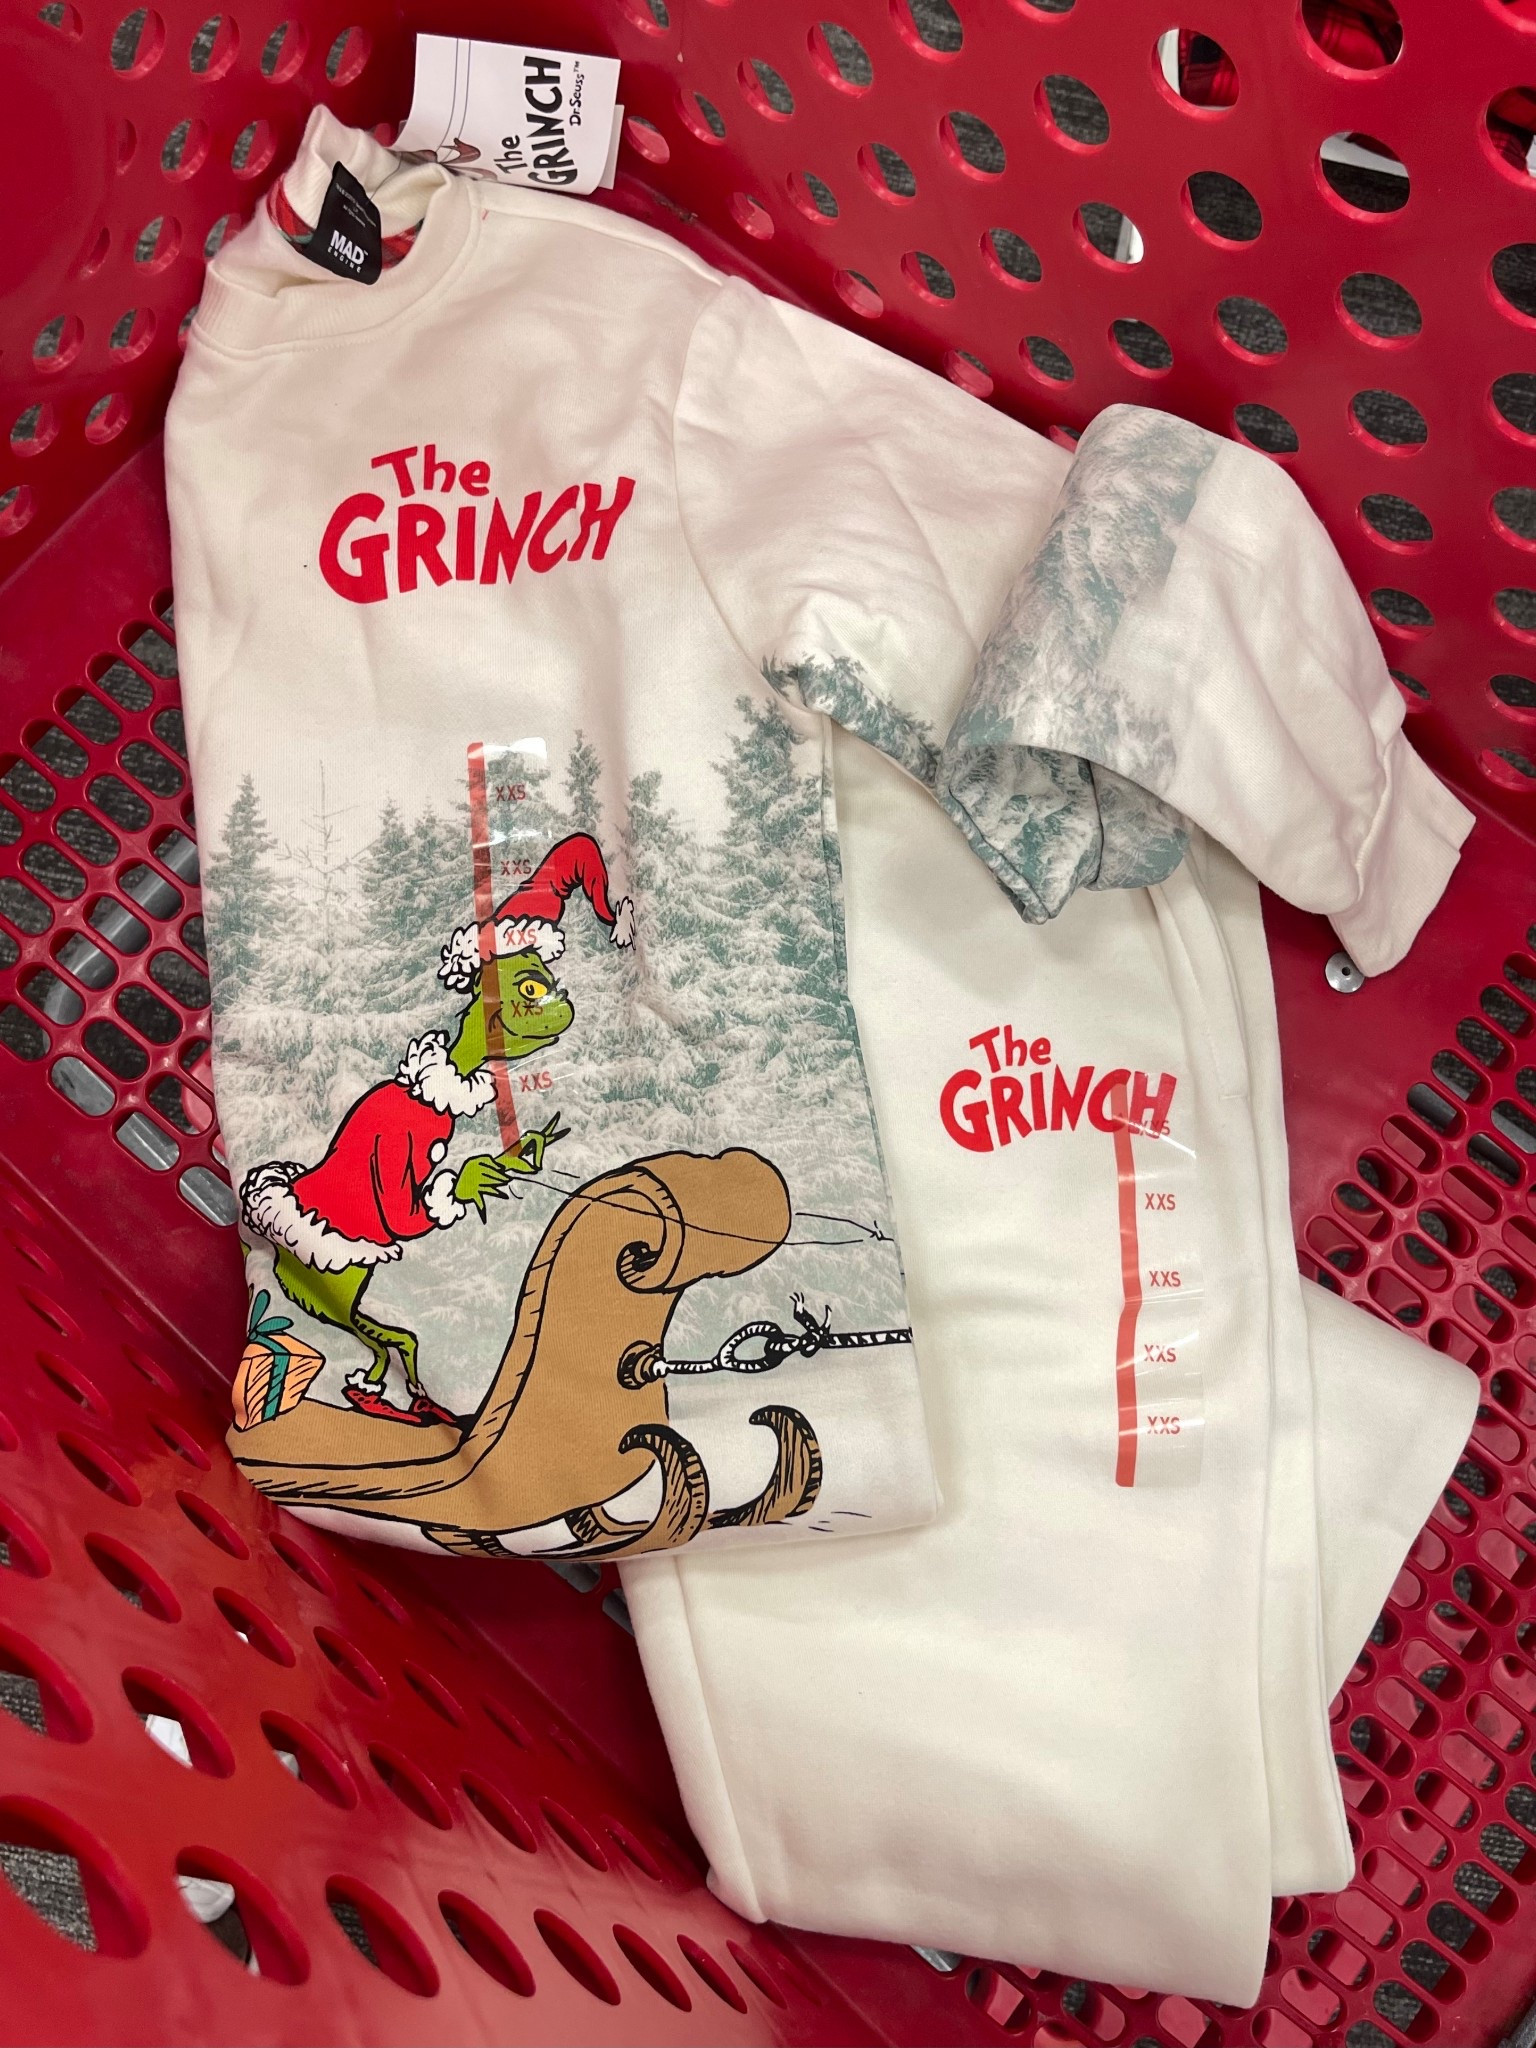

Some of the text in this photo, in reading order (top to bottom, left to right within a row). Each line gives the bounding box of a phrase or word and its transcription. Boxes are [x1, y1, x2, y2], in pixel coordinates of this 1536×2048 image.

[523, 55, 578, 186] GRINCH
[493, 134, 528, 174] The
[327, 246, 361, 273] ENGINE
[371, 443, 491, 498] The
[318, 476, 636, 605] GRINCH
[495, 784, 526, 801] XXS
[500, 859, 532, 875] XXS
[505, 928, 537, 946] XXS
[512, 1001, 544, 1017] XXS
[968, 1024, 1051, 1073] The
[519, 1071, 553, 1093] XXS
[939, 1064, 1178, 1153] GRINCH
[1145, 1193, 1176, 1210] XXS
[1149, 1270, 1181, 1287] XXS
[1144, 1344, 1177, 1362] XXS
[1147, 1416, 1180, 1434] XXS
